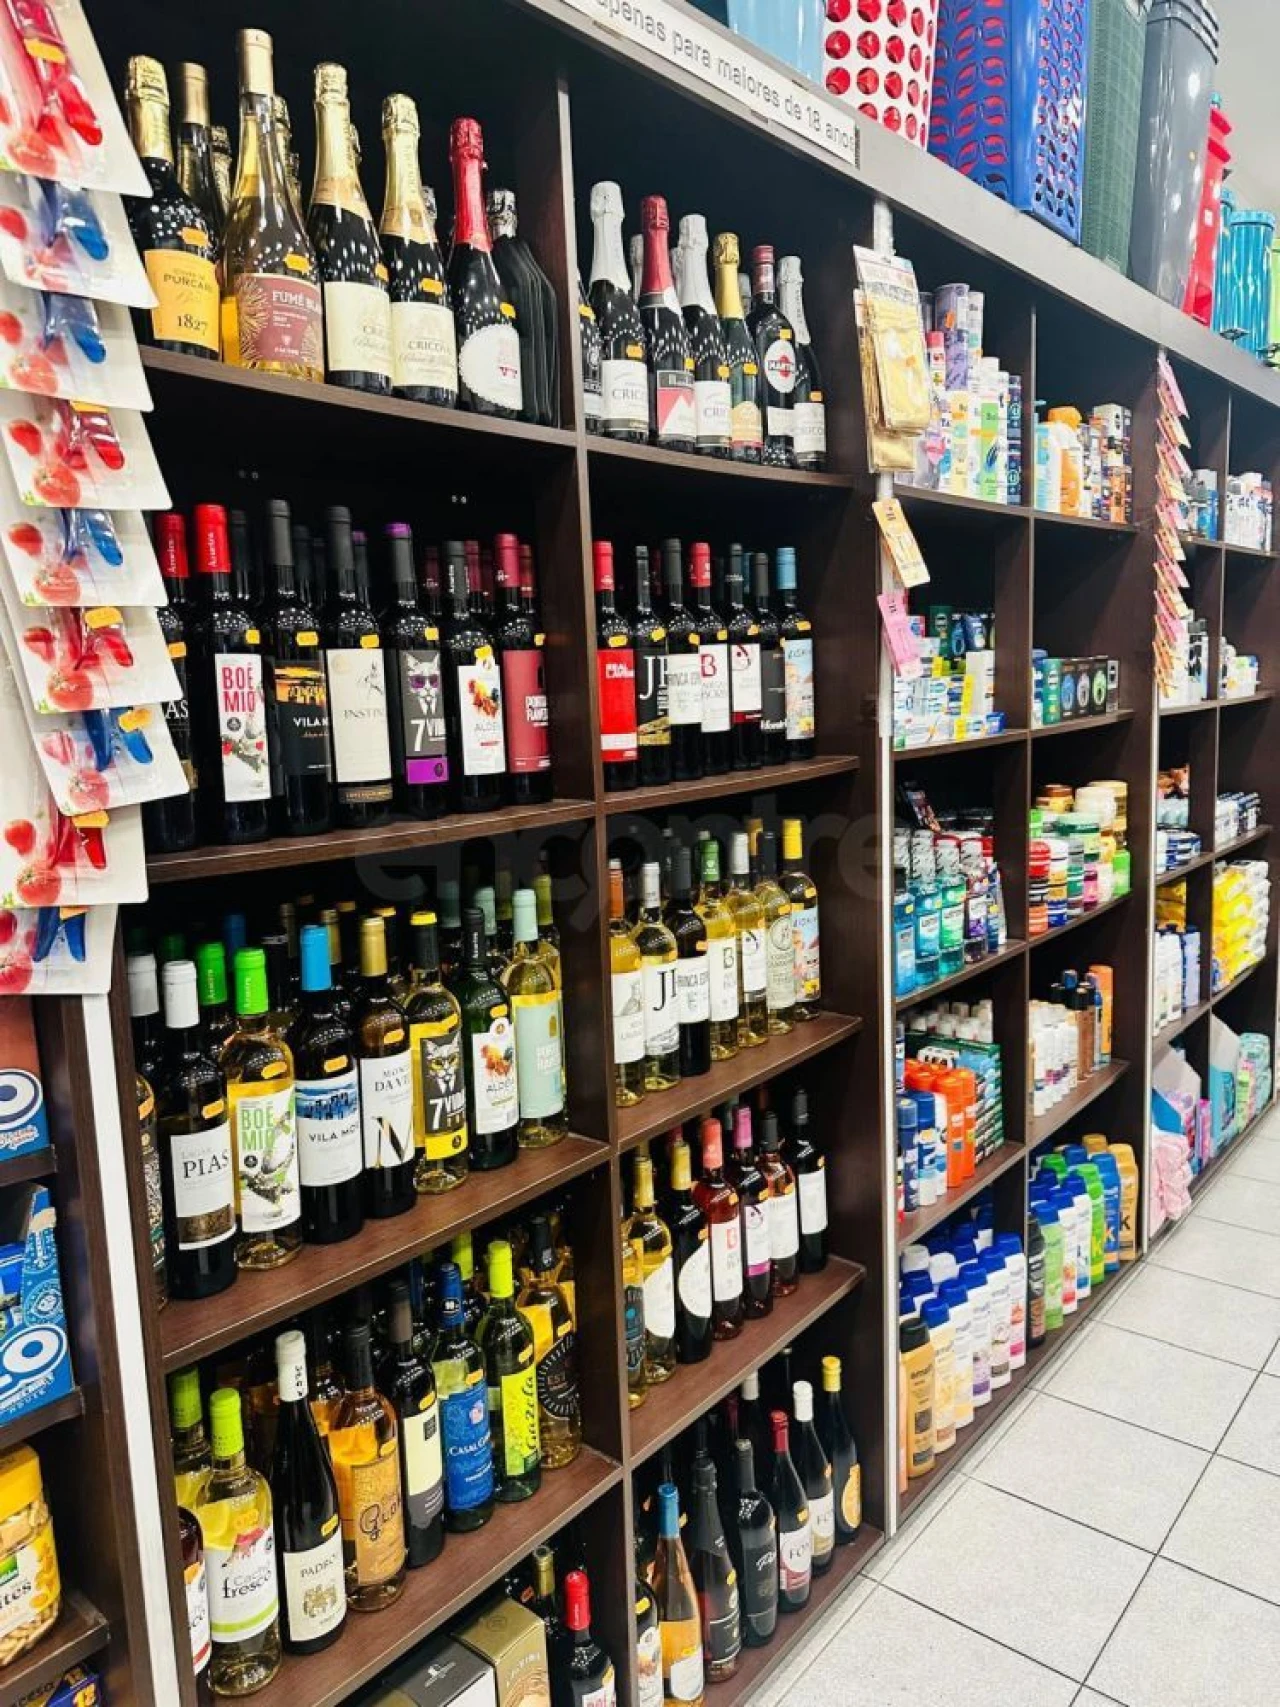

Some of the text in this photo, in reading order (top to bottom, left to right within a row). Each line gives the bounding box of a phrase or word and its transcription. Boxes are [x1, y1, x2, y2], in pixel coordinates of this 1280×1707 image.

[672, 30, 711, 69] para
[717, 56, 780, 109] maiores
[785, 95, 802, 121] de
[806, 106, 821, 132] 18
[177, 313, 208, 336] 1827
[223, 690, 256, 713] MIO
[293, 716, 320, 727] VILA
[411, 719, 426, 751] 7
[429, 1098, 443, 1130] 7
[309, 1132, 338, 1142] VILA
[183, 1153, 228, 1178] PIAS
